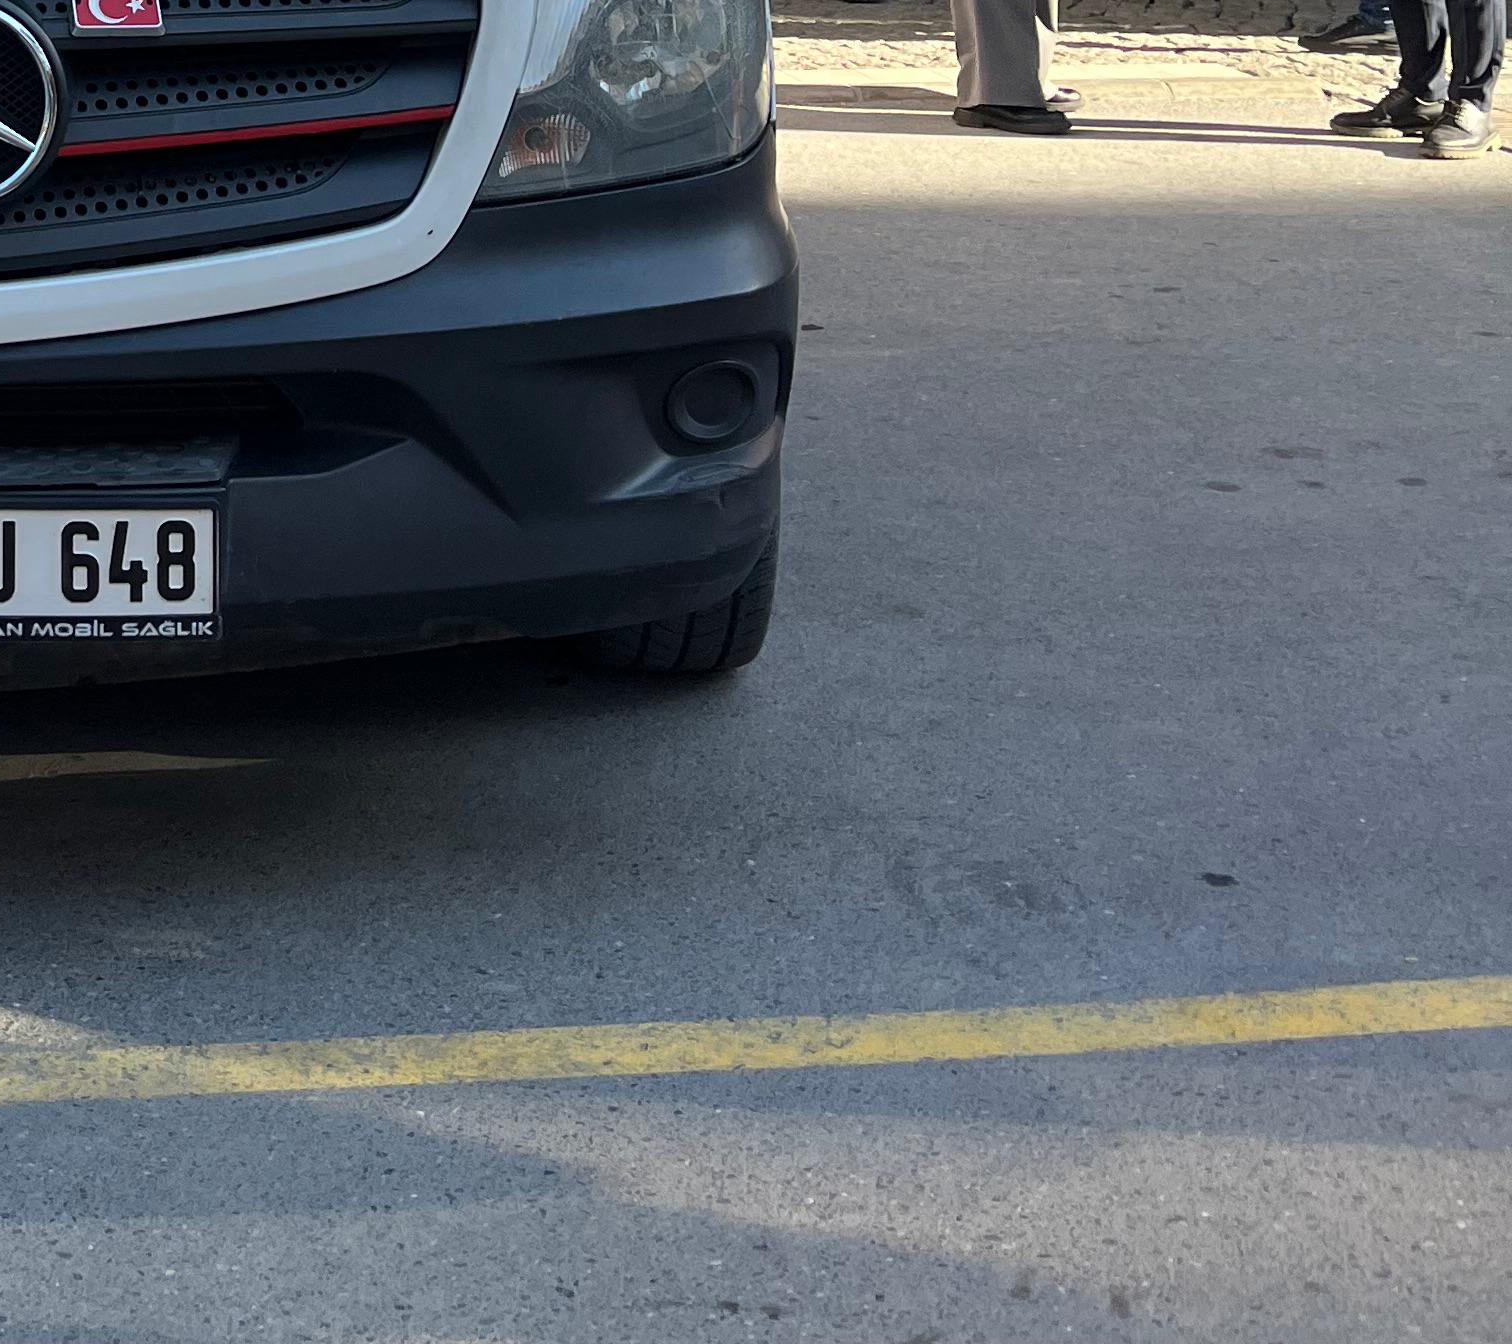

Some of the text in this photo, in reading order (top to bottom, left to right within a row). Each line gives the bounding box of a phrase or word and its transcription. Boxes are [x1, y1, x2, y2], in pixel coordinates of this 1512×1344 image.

[60, 520, 196, 603] 648
[30, 619, 114, 637] MOBİL
[121, 619, 214, 637] SAĞLIK
